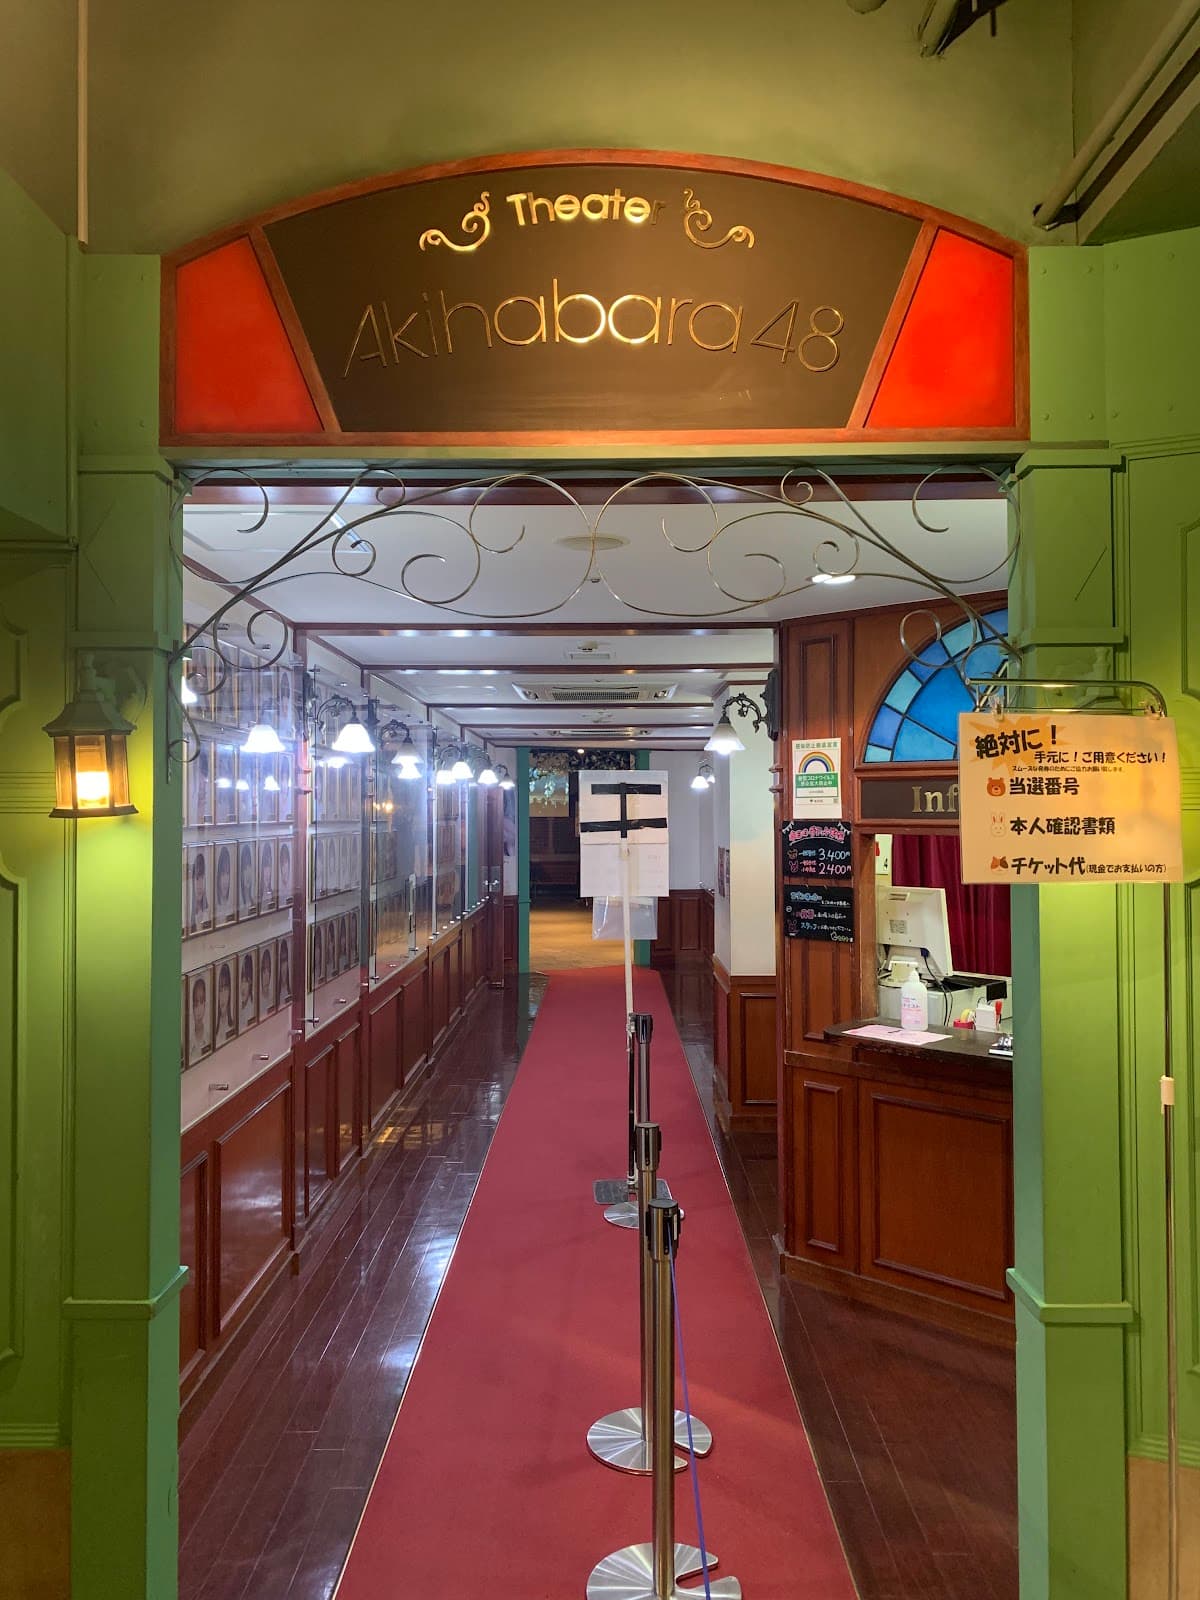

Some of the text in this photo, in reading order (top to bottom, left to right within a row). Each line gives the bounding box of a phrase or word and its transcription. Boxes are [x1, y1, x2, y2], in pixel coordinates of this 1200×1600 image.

[506, 187, 667, 226] Theater
[343, 278, 845, 378] Akihabara 48
[974, 724, 1058, 760] 絶対に！
[1009, 777, 1080, 796] 当選番号
[1010, 817, 1116, 836] 本人確認書類
